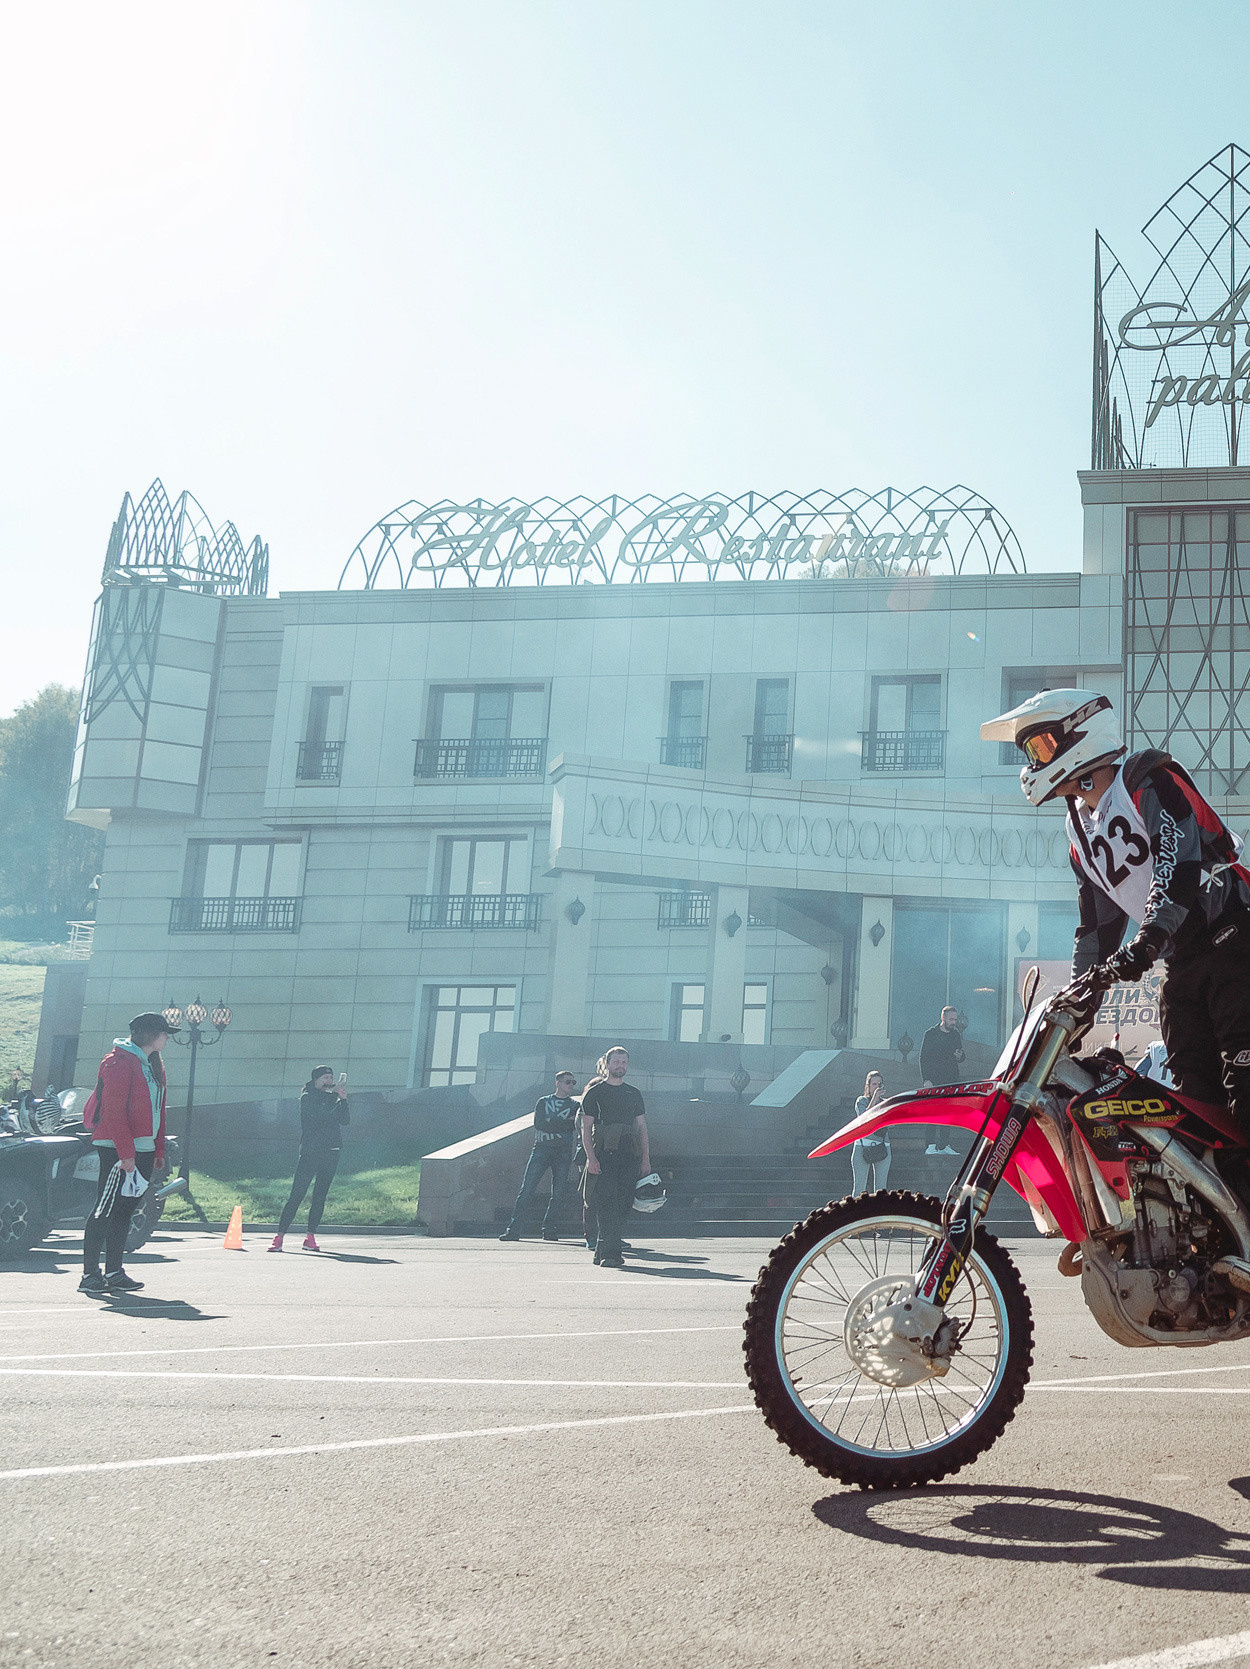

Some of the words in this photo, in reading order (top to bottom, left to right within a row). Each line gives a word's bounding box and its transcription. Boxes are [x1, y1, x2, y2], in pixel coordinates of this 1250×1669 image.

[411, 505, 613, 572] Hotel
[618, 500, 949, 568] Restaurant
[1095, 1078, 1123, 1095] HONDA
[1083, 1098, 1166, 1119] GEICO
[985, 1117, 1023, 1180] SHOWA
